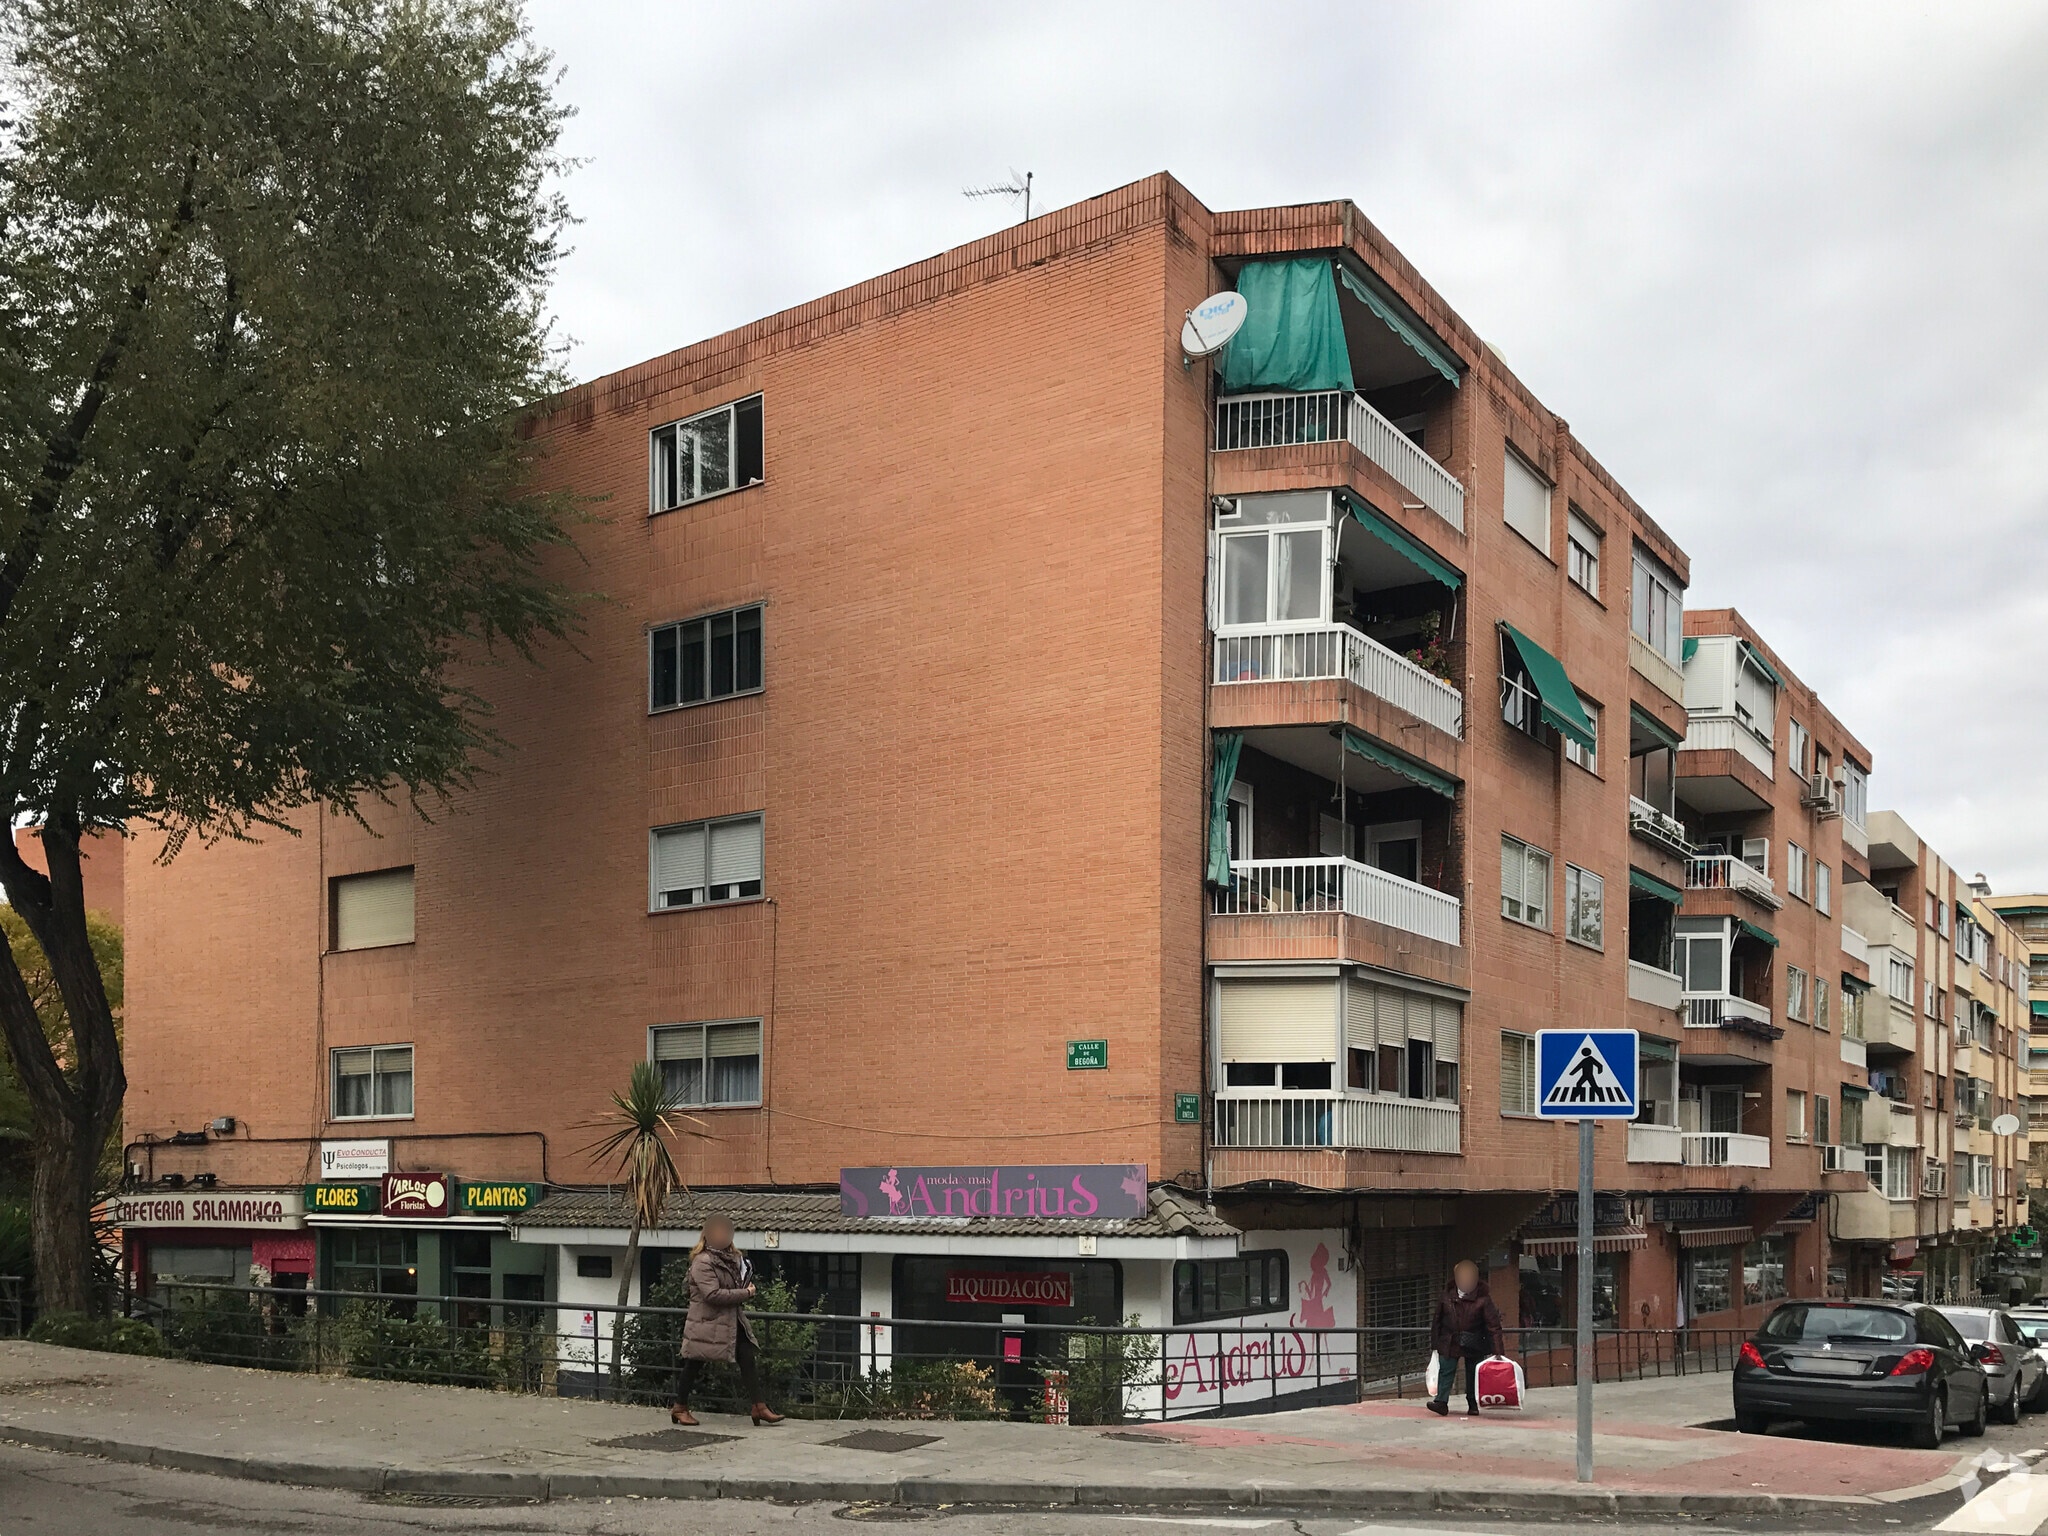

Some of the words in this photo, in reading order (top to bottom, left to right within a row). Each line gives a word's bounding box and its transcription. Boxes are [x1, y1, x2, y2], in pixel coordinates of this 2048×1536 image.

[1074, 1055, 1098, 1066] BEGOÑA
[926, 1172, 958, 1185] moda
[967, 1176, 991, 1185] mas
[315, 1187, 359, 1207] FLORES
[400, 1200, 425, 1210] Floristas
[467, 1186, 527, 1207] PLANTAS
[115, 1199, 185, 1222] CAFETERIA
[192, 1199, 283, 1222] SALAMANCA
[1668, 1199, 1699, 1219] HIPER
[1702, 1199, 1733, 1218] BAZAR
[949, 1274, 1068, 1301] LIQUIDACIÓN
